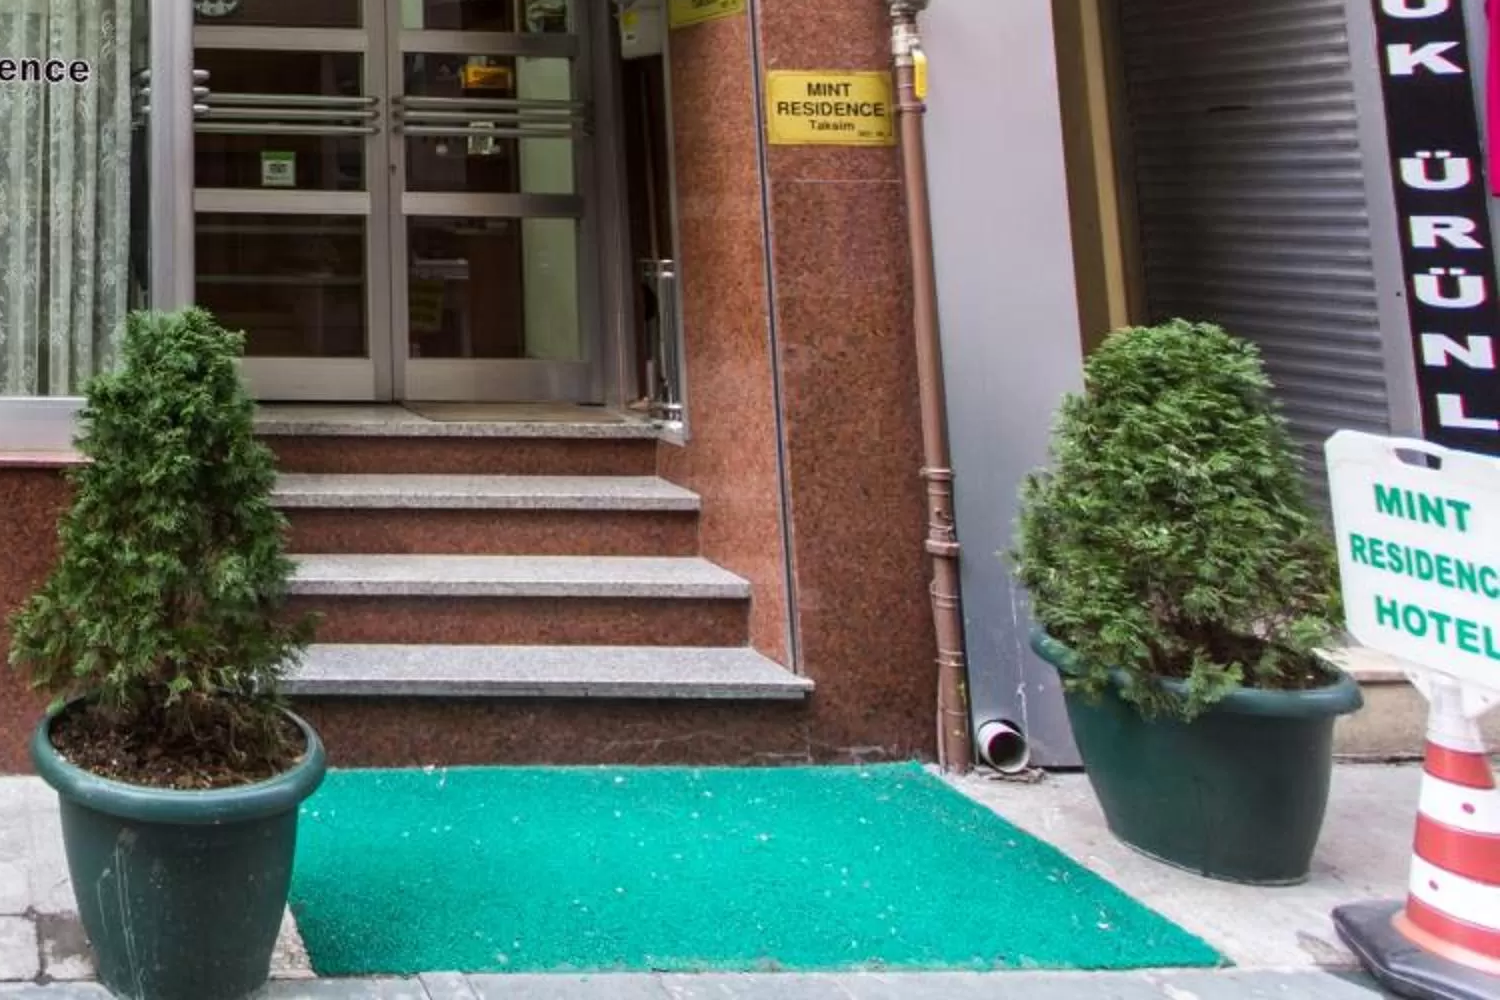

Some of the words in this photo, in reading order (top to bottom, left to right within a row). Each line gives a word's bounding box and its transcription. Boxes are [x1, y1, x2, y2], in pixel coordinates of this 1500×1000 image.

[806, 81, 852, 97] MINT
[776, 101, 885, 117] RESIDENCE
[808, 119, 855, 131] Taksim
[1373, 482, 1471, 533] MINT
[1374, 594, 1500, 661] HOTEL
